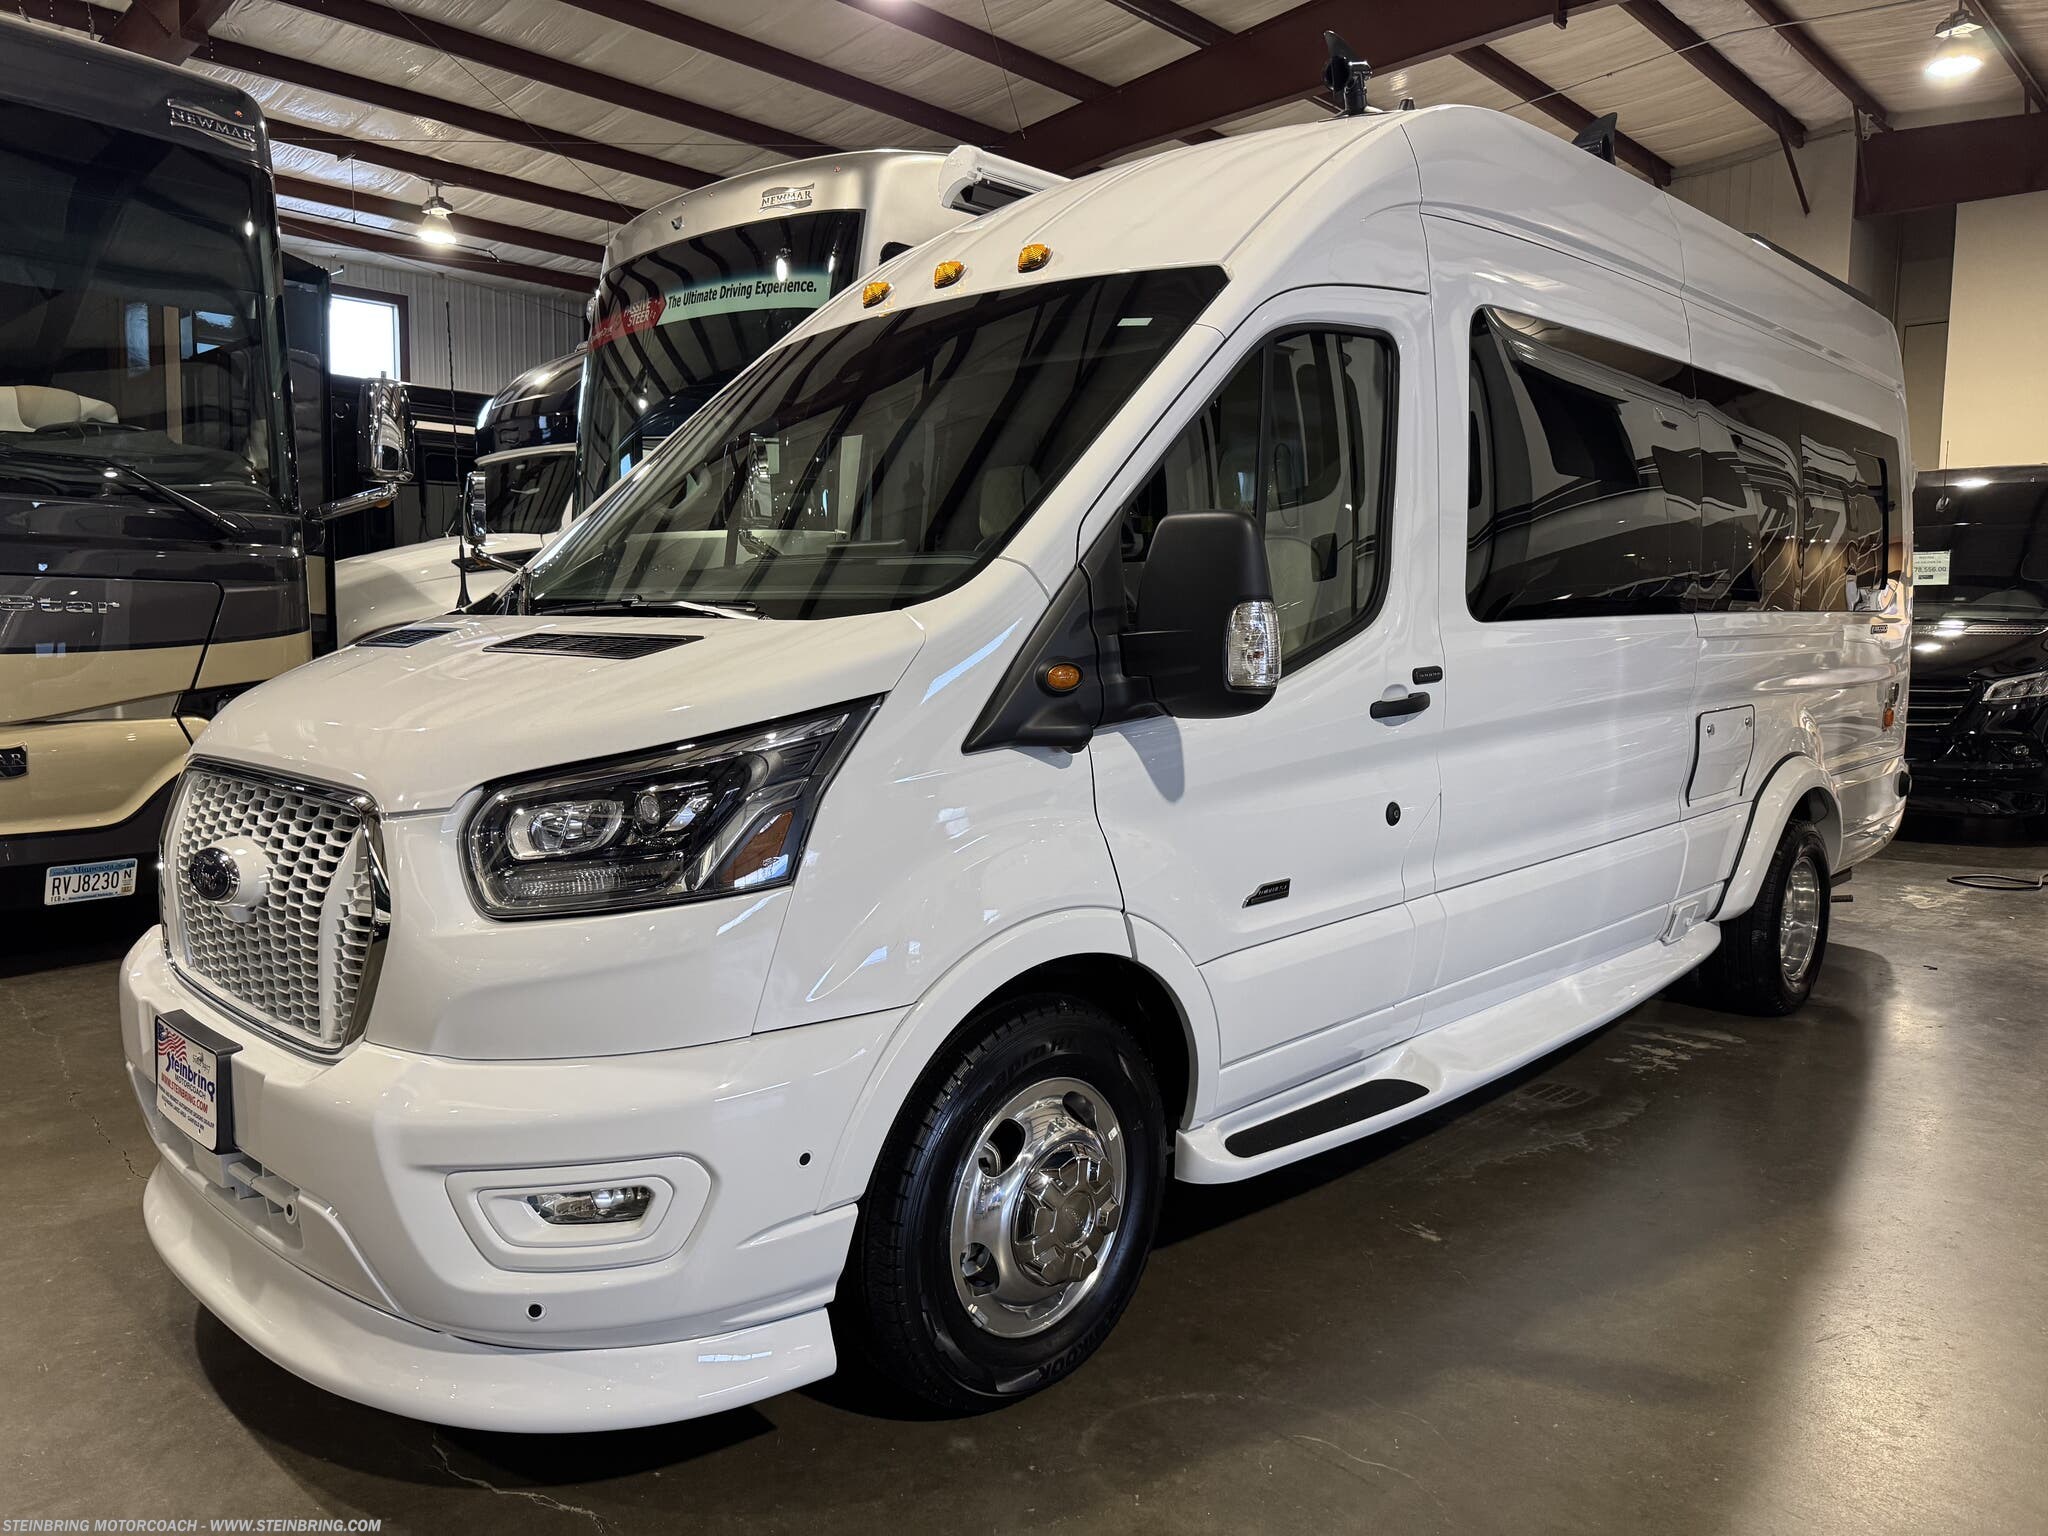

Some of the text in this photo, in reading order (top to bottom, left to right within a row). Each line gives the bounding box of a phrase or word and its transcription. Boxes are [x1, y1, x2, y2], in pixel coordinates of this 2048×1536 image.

[171, 108, 256, 143] NEWMAR
[761, 190, 813, 207] NEWMAR
[668, 278, 817, 309] The Ultimate Driving Experience.
[627, 309, 650, 328] STEER
[51, 871, 120, 896] RVJ8230
[165, 1051, 216, 1102] Steinbring
